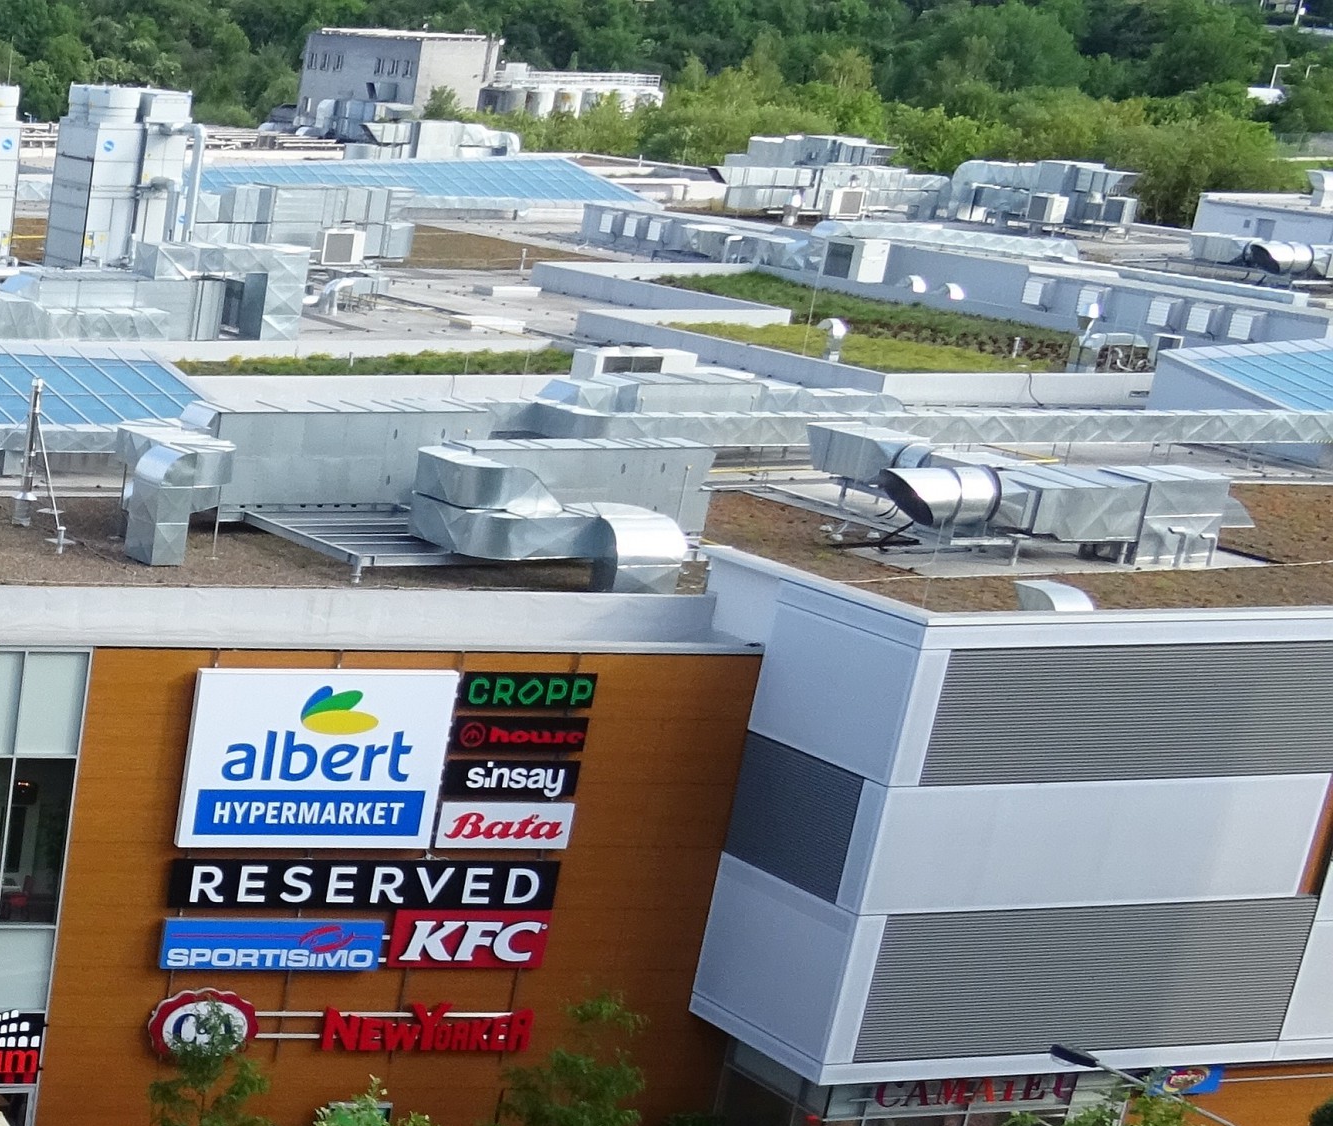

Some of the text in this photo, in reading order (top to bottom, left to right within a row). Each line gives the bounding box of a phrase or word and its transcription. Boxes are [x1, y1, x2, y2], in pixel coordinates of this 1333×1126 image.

[468, 676, 593, 706] CROPP
[489, 726, 585, 744] house
[221, 729, 413, 782] albert
[465, 761, 565, 798] sinsay
[212, 801, 405, 825] HYPERMARKET
[189, 865, 541, 904] RESERVED
[399, 920, 540, 962] KFC
